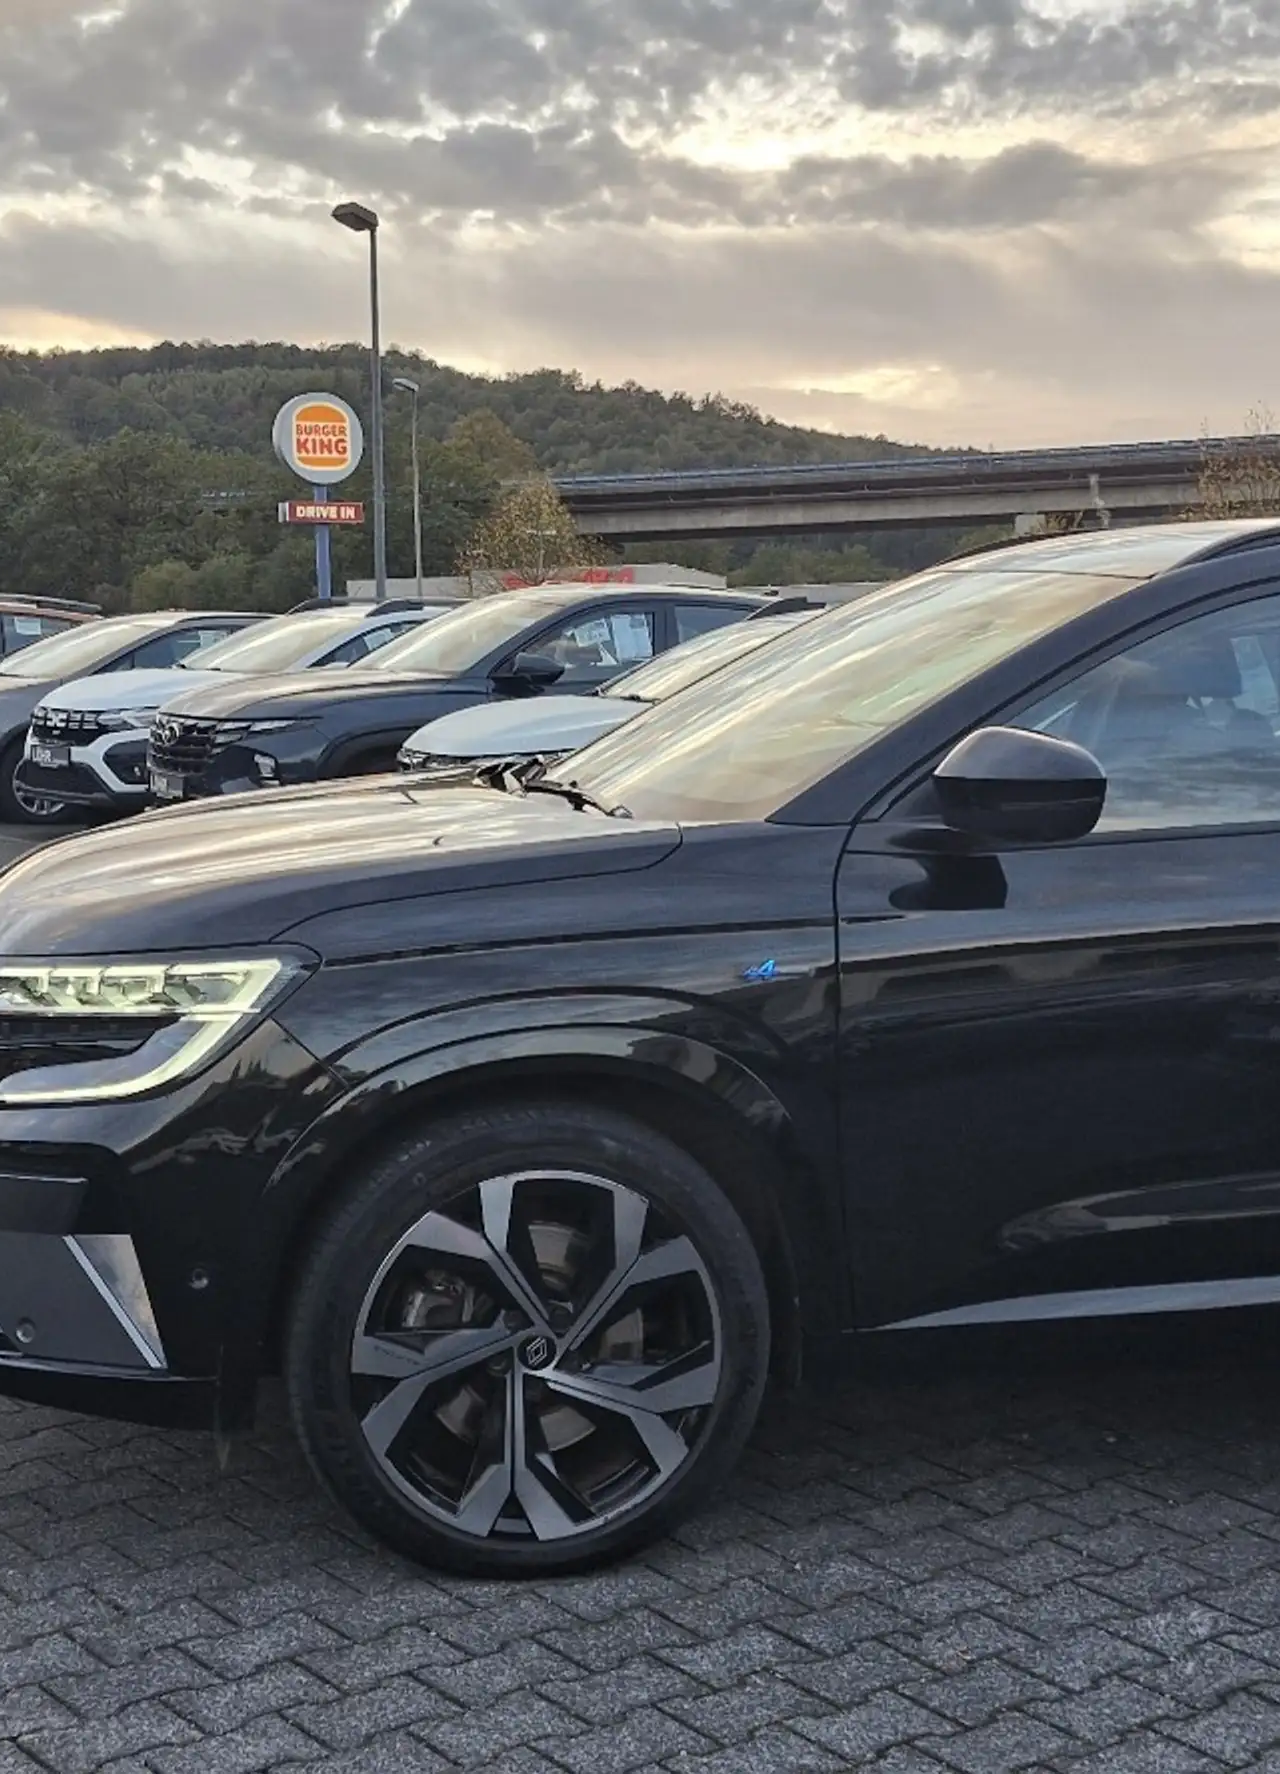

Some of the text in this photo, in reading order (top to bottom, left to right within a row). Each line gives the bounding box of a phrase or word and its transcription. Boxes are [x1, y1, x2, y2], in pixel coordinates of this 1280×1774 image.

[296, 423, 347, 437] BURGER
[296, 438, 347, 455] KING
[296, 505, 355, 519] DRIVE IN
